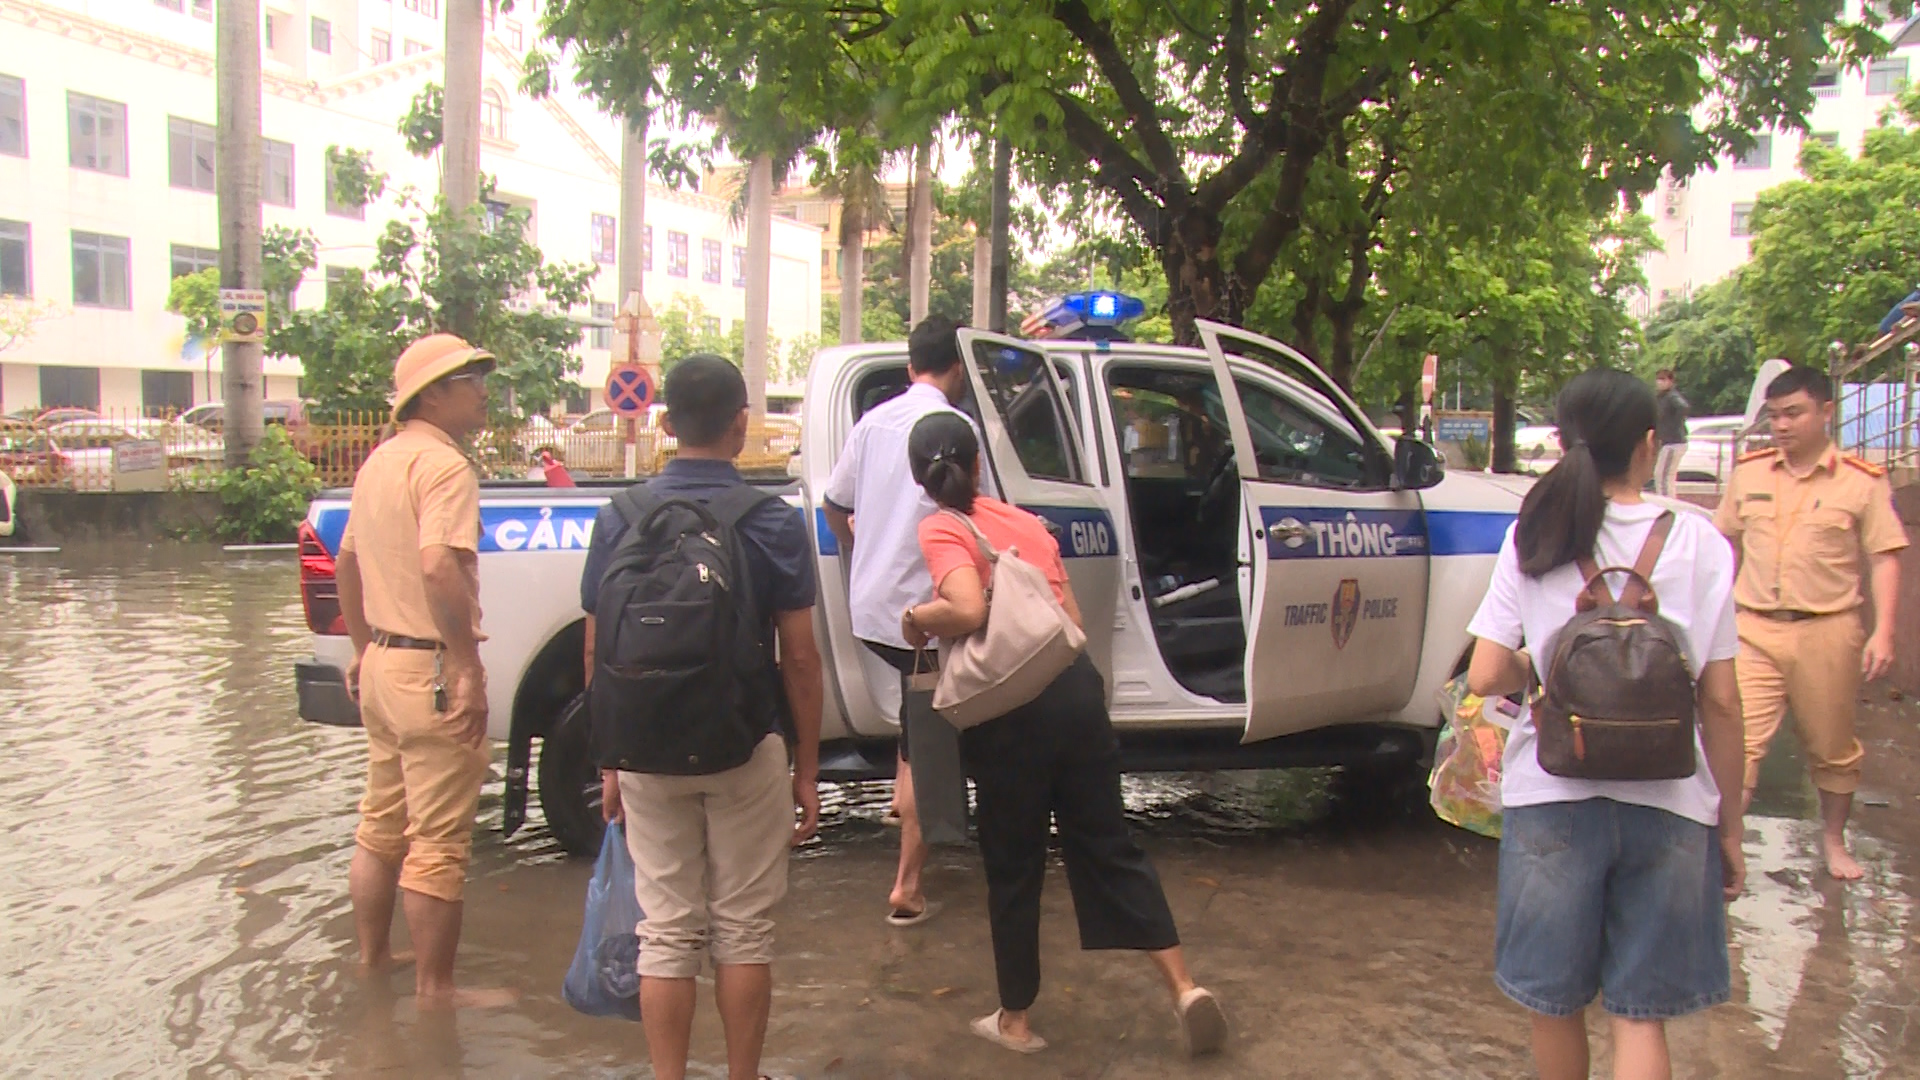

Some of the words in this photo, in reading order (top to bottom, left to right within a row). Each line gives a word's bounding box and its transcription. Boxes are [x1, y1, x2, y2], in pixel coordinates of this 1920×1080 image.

[1071, 521, 1109, 555] GIAO
[1309, 511, 1398, 556] THÔNG
[1284, 603, 1328, 627] TRAFFIC
[1362, 597, 1398, 621] POLICE
